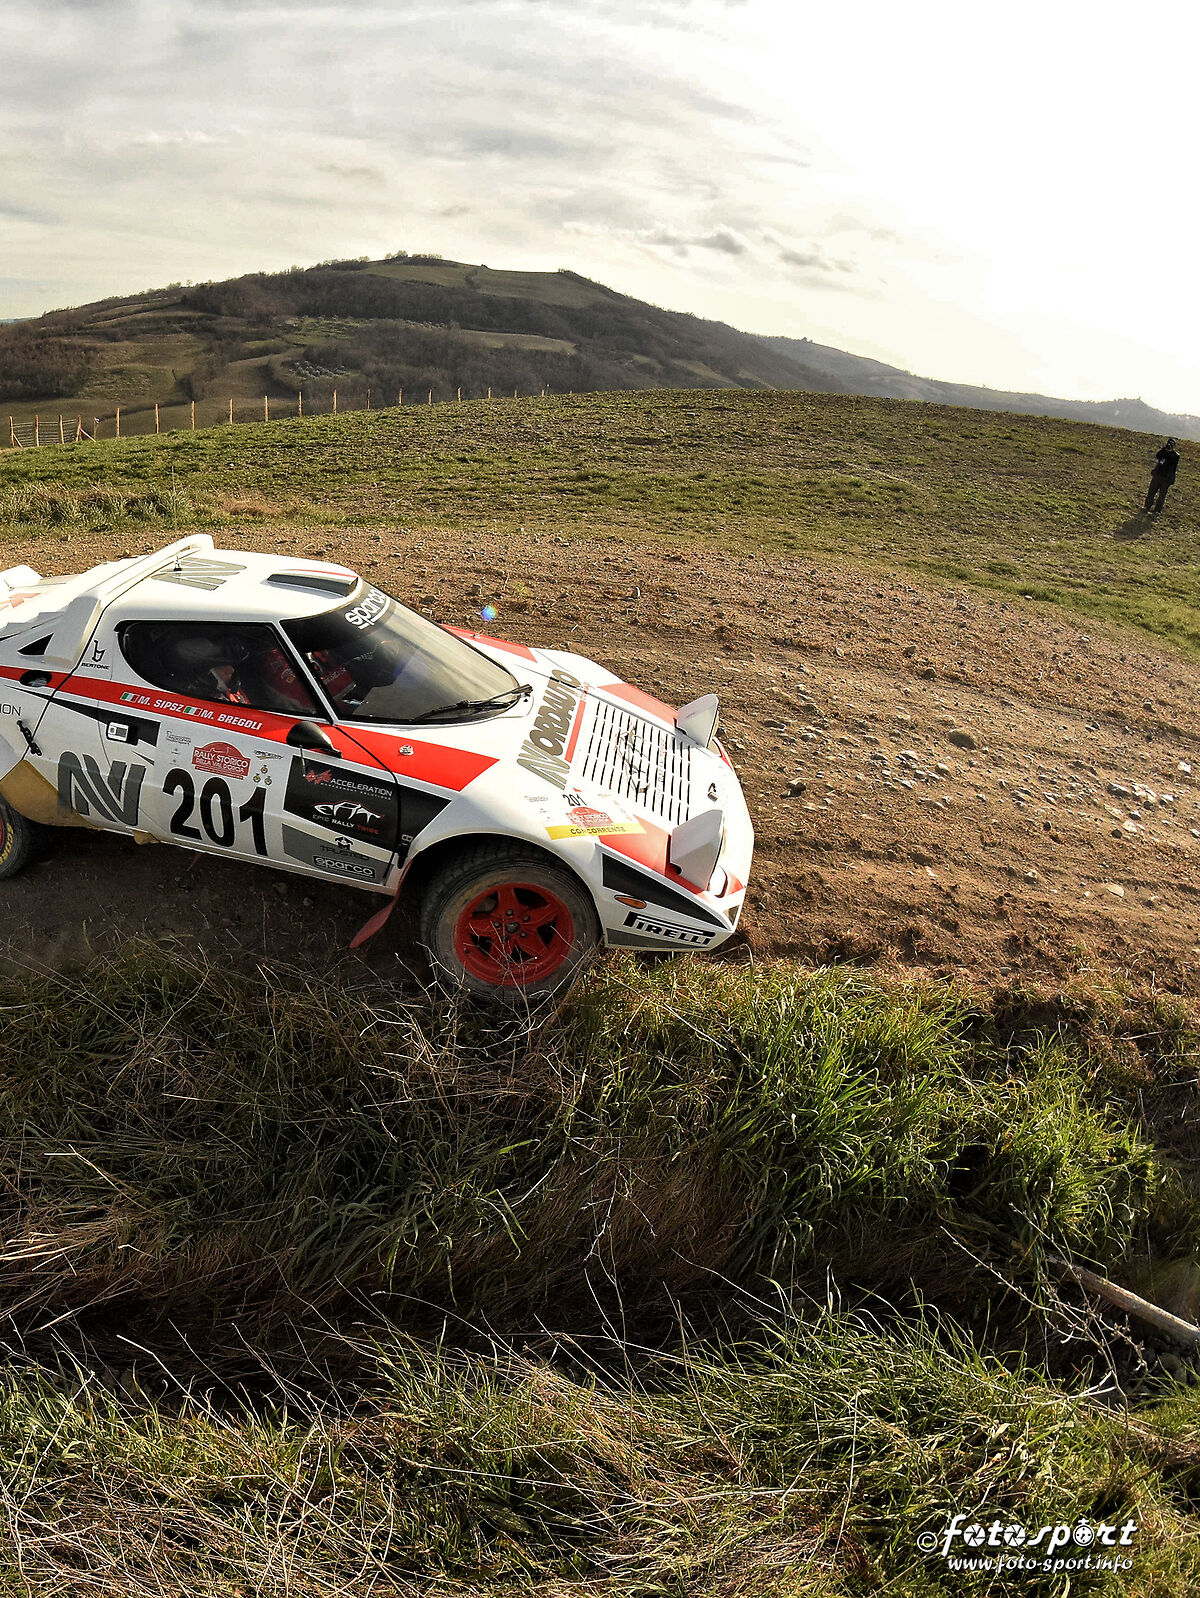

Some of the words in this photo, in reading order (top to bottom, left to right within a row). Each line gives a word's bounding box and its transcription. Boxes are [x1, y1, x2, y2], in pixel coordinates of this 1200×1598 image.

[81, 662, 110, 670] BERTONE
[137, 696, 151, 706] M.
[153, 699, 184, 713] SIPSZ
[201, 709, 214, 720] M.
[217, 713, 262, 731] BREGOLI
[193, 749, 215, 761] RALLY
[216, 756, 249, 768] STORICO
[330, 778, 393, 797] ACCELERATION
[562, 794, 587, 807] 201
[162, 768, 268, 856] 201
[332, 819, 355, 828] RALLY
[570, 826, 627, 835] CONCORRENTE
[314, 857, 374, 878] sparco
[622, 911, 716, 945] PIRELLI
